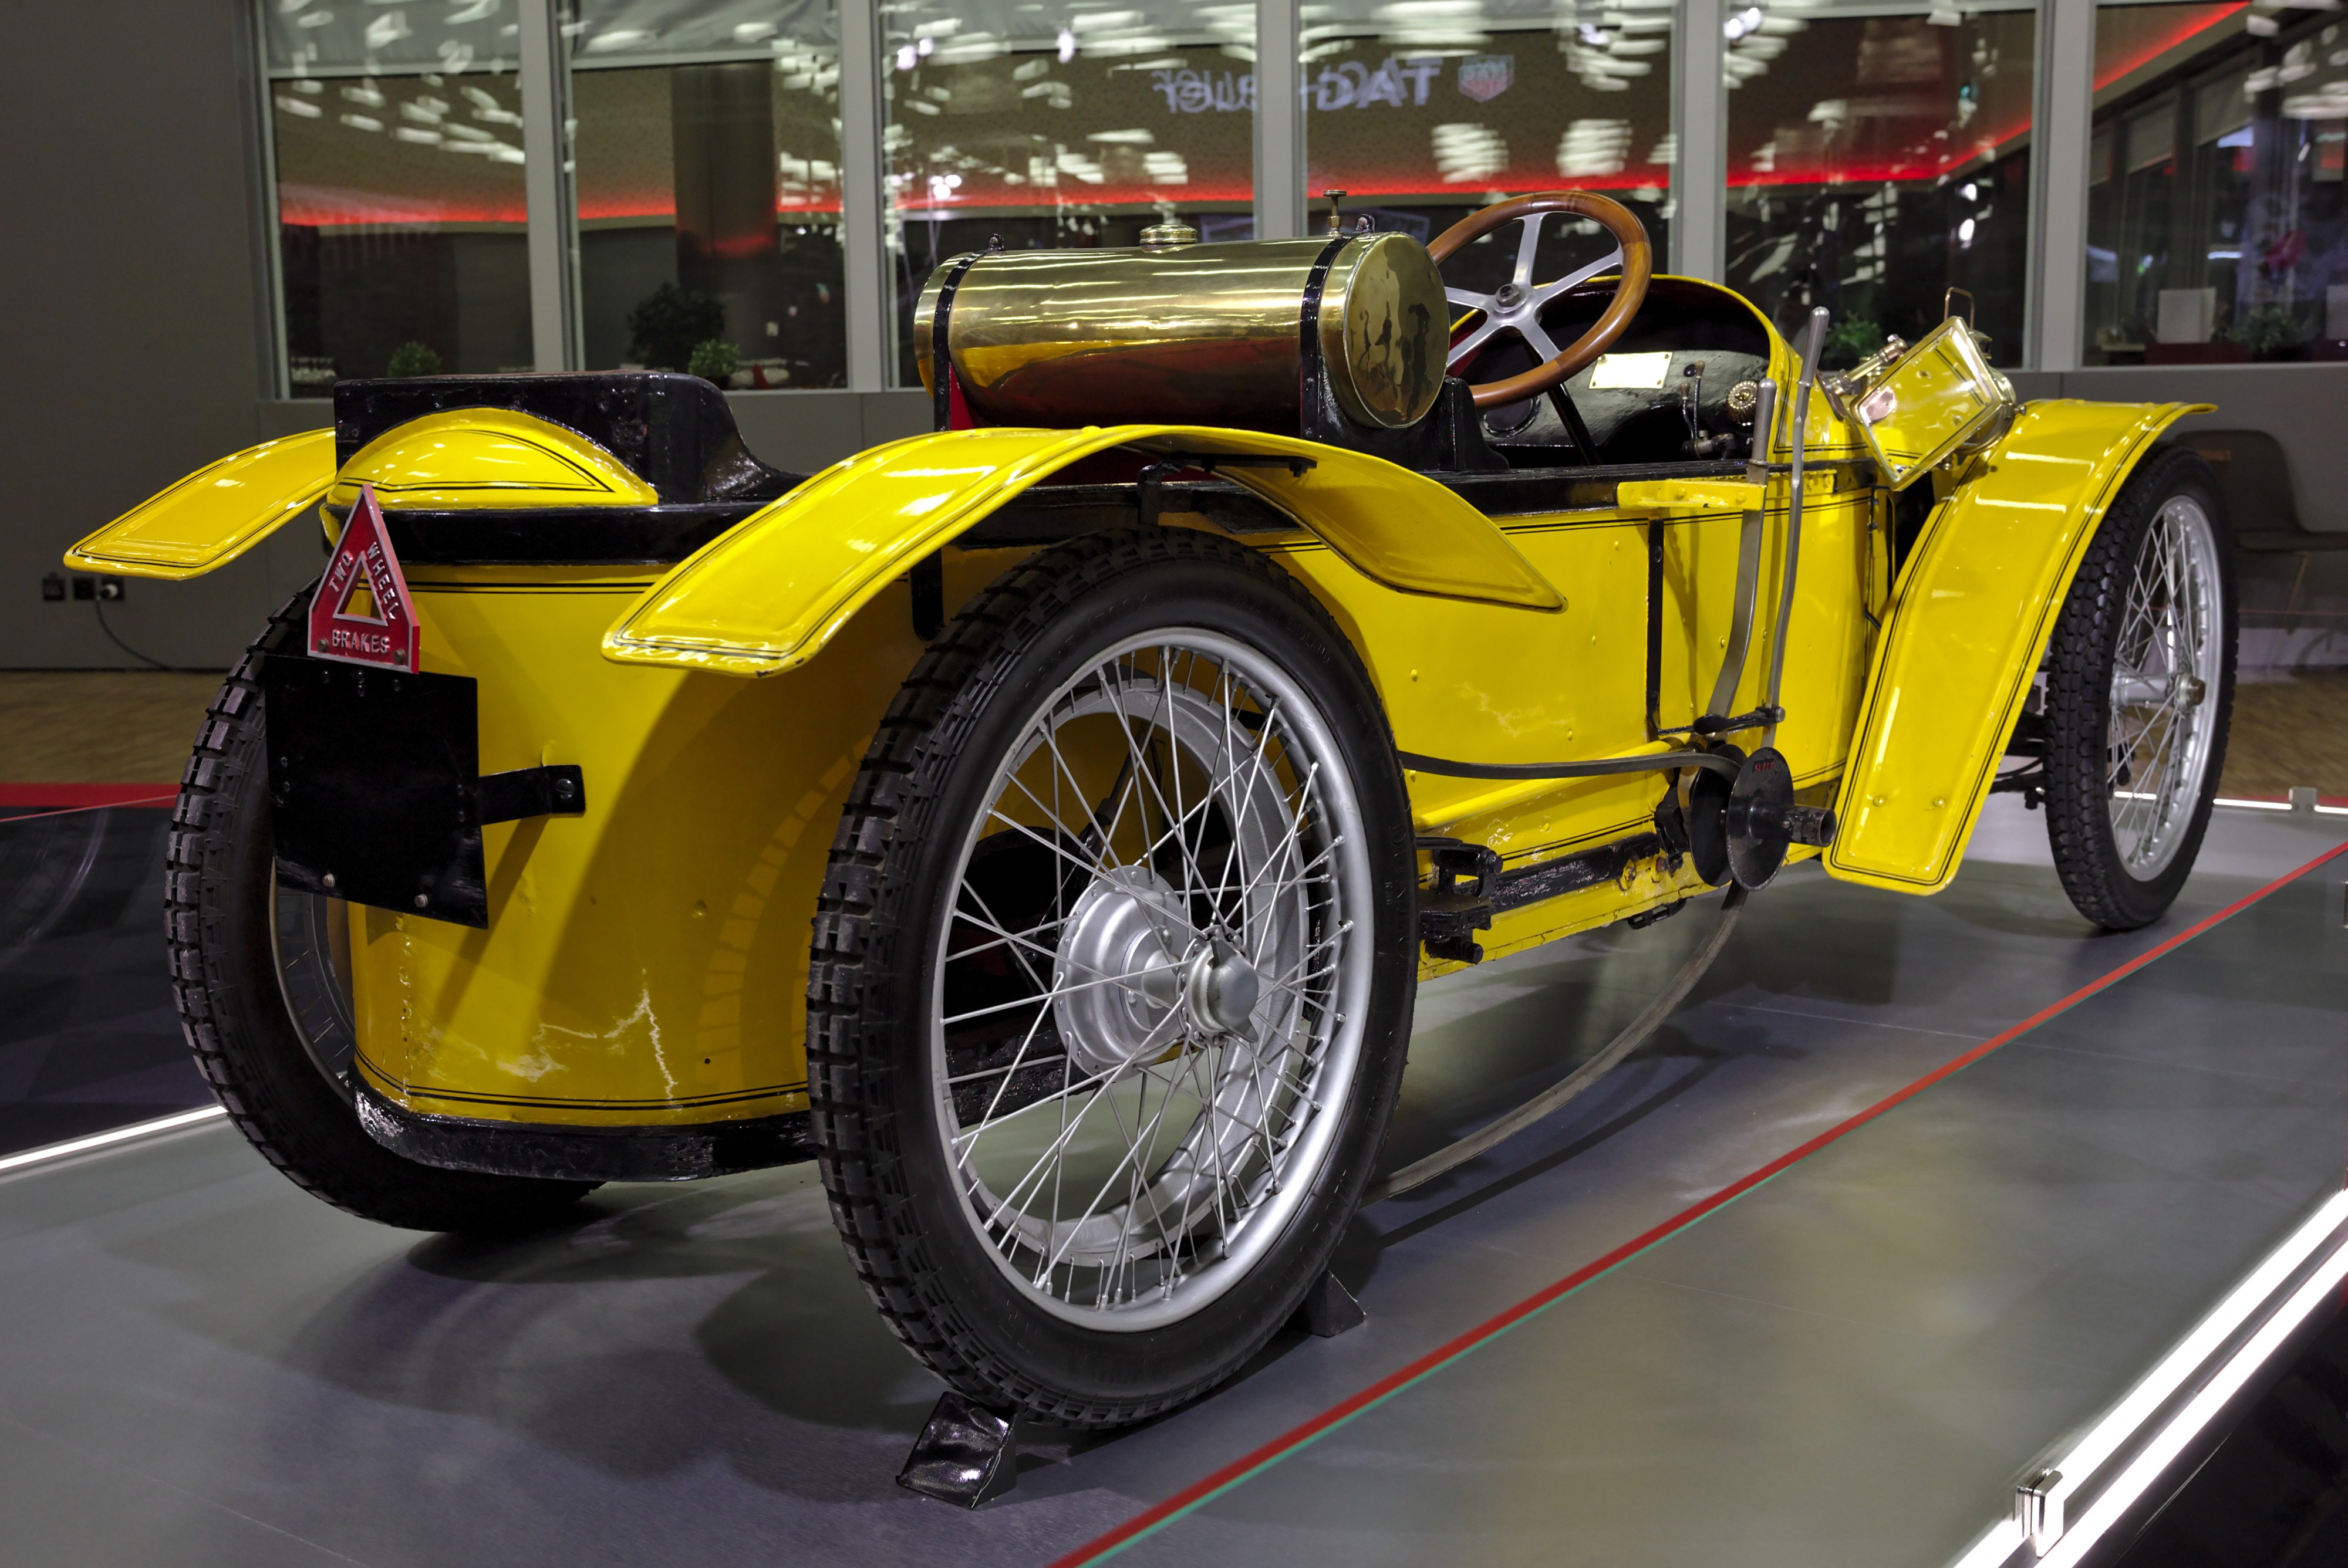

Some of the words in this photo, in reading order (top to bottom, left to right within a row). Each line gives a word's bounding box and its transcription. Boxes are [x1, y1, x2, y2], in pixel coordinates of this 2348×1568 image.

[328, 550, 353, 592] TWO
[367, 542, 399, 620] WHEEL
[332, 628, 391, 654] BRAKES
[1389, 817, 1413, 986] DUNLOP
